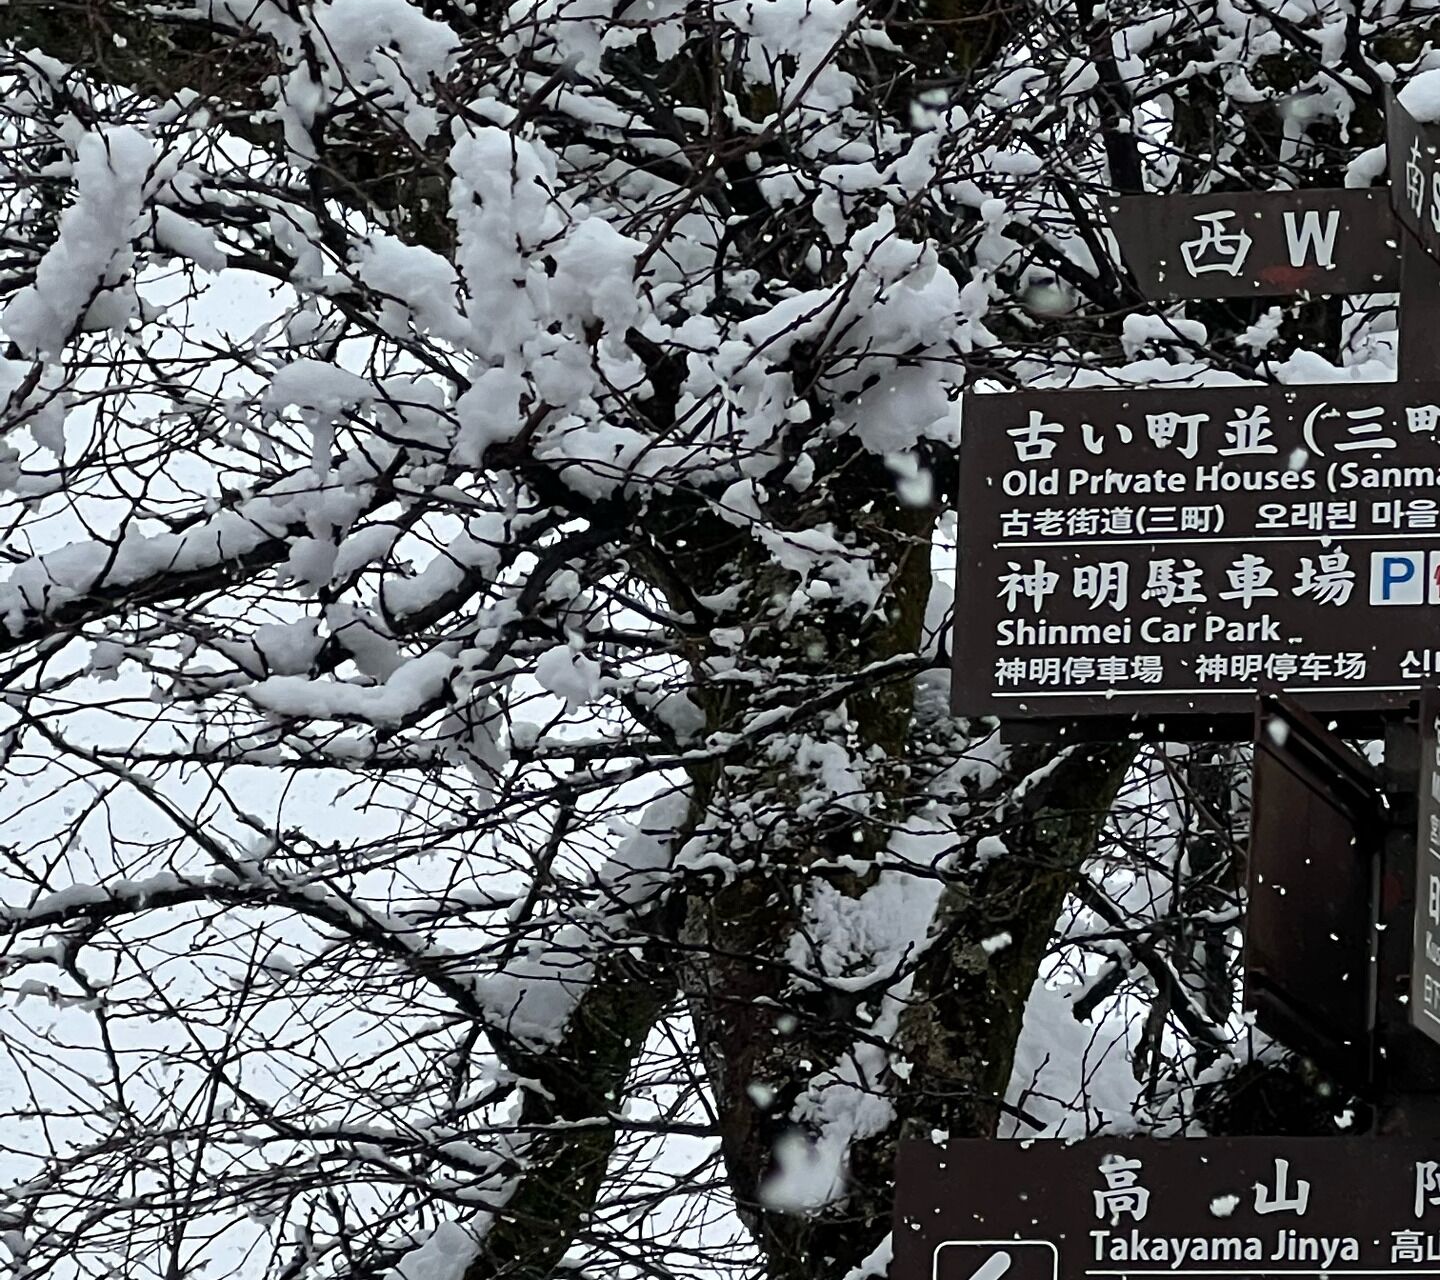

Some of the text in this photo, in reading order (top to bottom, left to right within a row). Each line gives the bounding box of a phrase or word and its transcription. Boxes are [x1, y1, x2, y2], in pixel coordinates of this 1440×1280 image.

[1406, 135, 1425, 218] 南
[1179, 208, 1342, 278] 西 W
[1002, 469, 1058, 496] Old
[1068, 468, 1186, 495] Private
[1196, 465, 1315, 492] Houses
[1000, 504, 1224, 537] 古老街道(三町)
[1256, 501, 1359, 531] 오래된
[997, 551, 1356, 613] 神明駐車場
[996, 614, 1280, 647] Shinmei Car Park
[995, 655, 1163, 685] 神明停車場
[1196, 652, 1367, 681] 神明停车场
[1089, 1230, 1262, 1269] Takayama
[1271, 1229, 1358, 1268] Jinya
